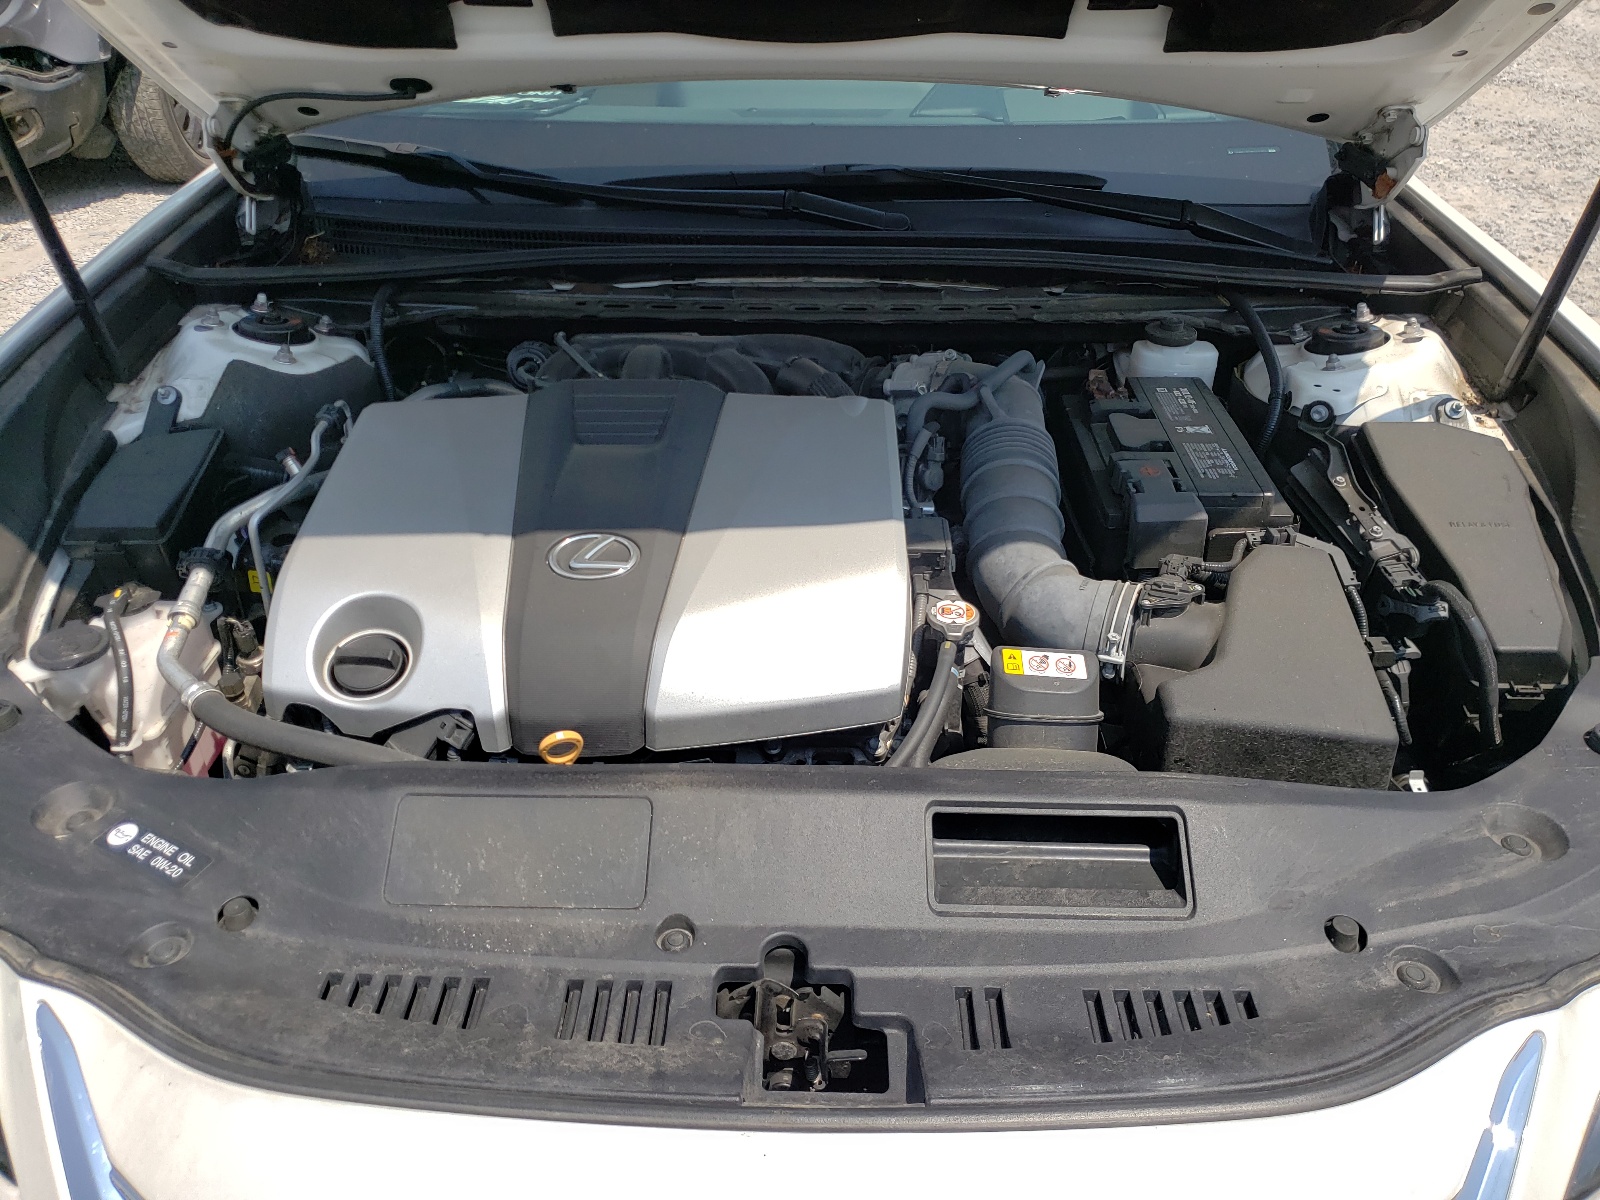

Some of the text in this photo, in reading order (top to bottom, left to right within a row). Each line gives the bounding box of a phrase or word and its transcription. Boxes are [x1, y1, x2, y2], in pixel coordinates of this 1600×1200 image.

[127, 844, 183, 878] SAE 0W-20
[140, 832, 196, 867] ENGINE OIL
